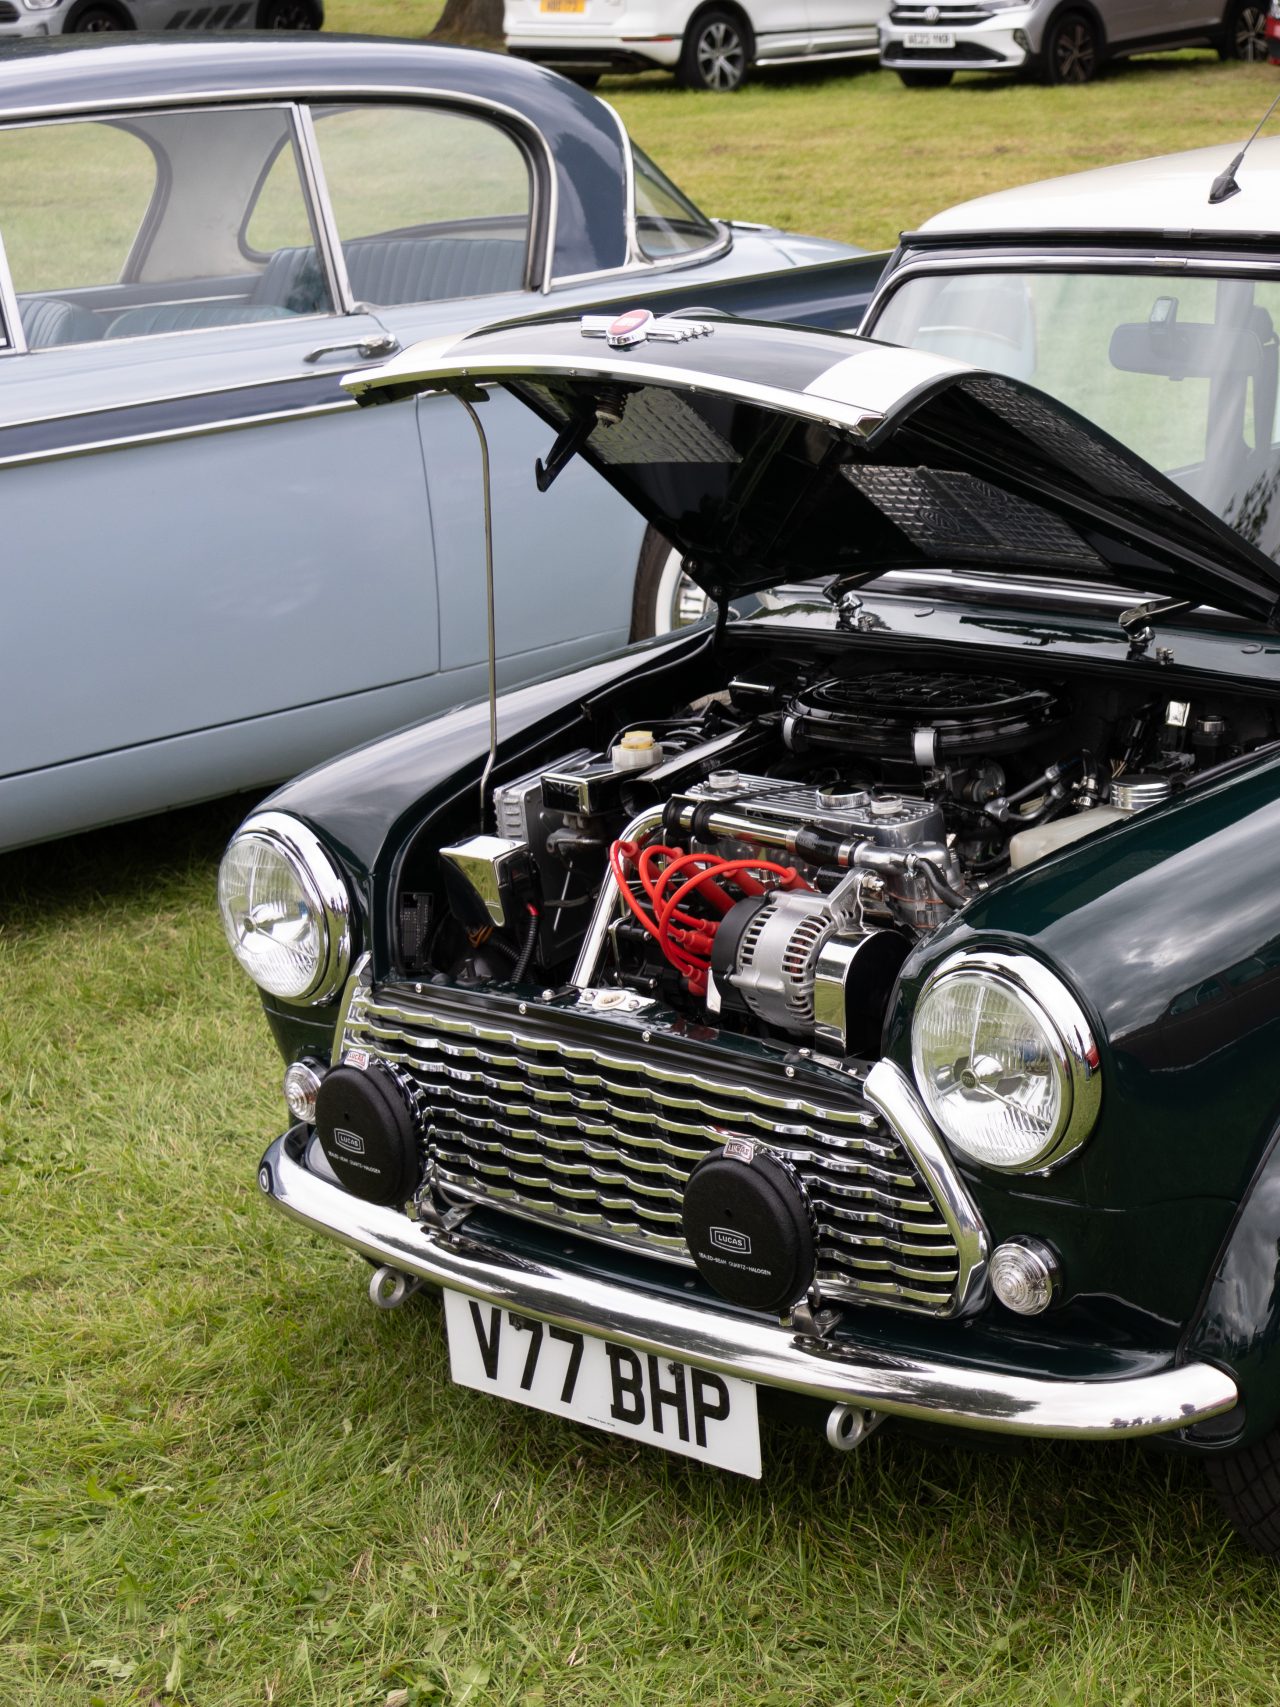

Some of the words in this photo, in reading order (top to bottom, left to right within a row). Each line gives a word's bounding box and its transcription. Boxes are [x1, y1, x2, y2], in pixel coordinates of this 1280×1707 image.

[340, 1135, 359, 1147] LUCAS
[727, 1143, 750, 1156] LUCAS
[718, 1234, 743, 1247] LUCAS
[468, 1299, 585, 1405] V77
[605, 1340, 731, 1449] BHP
